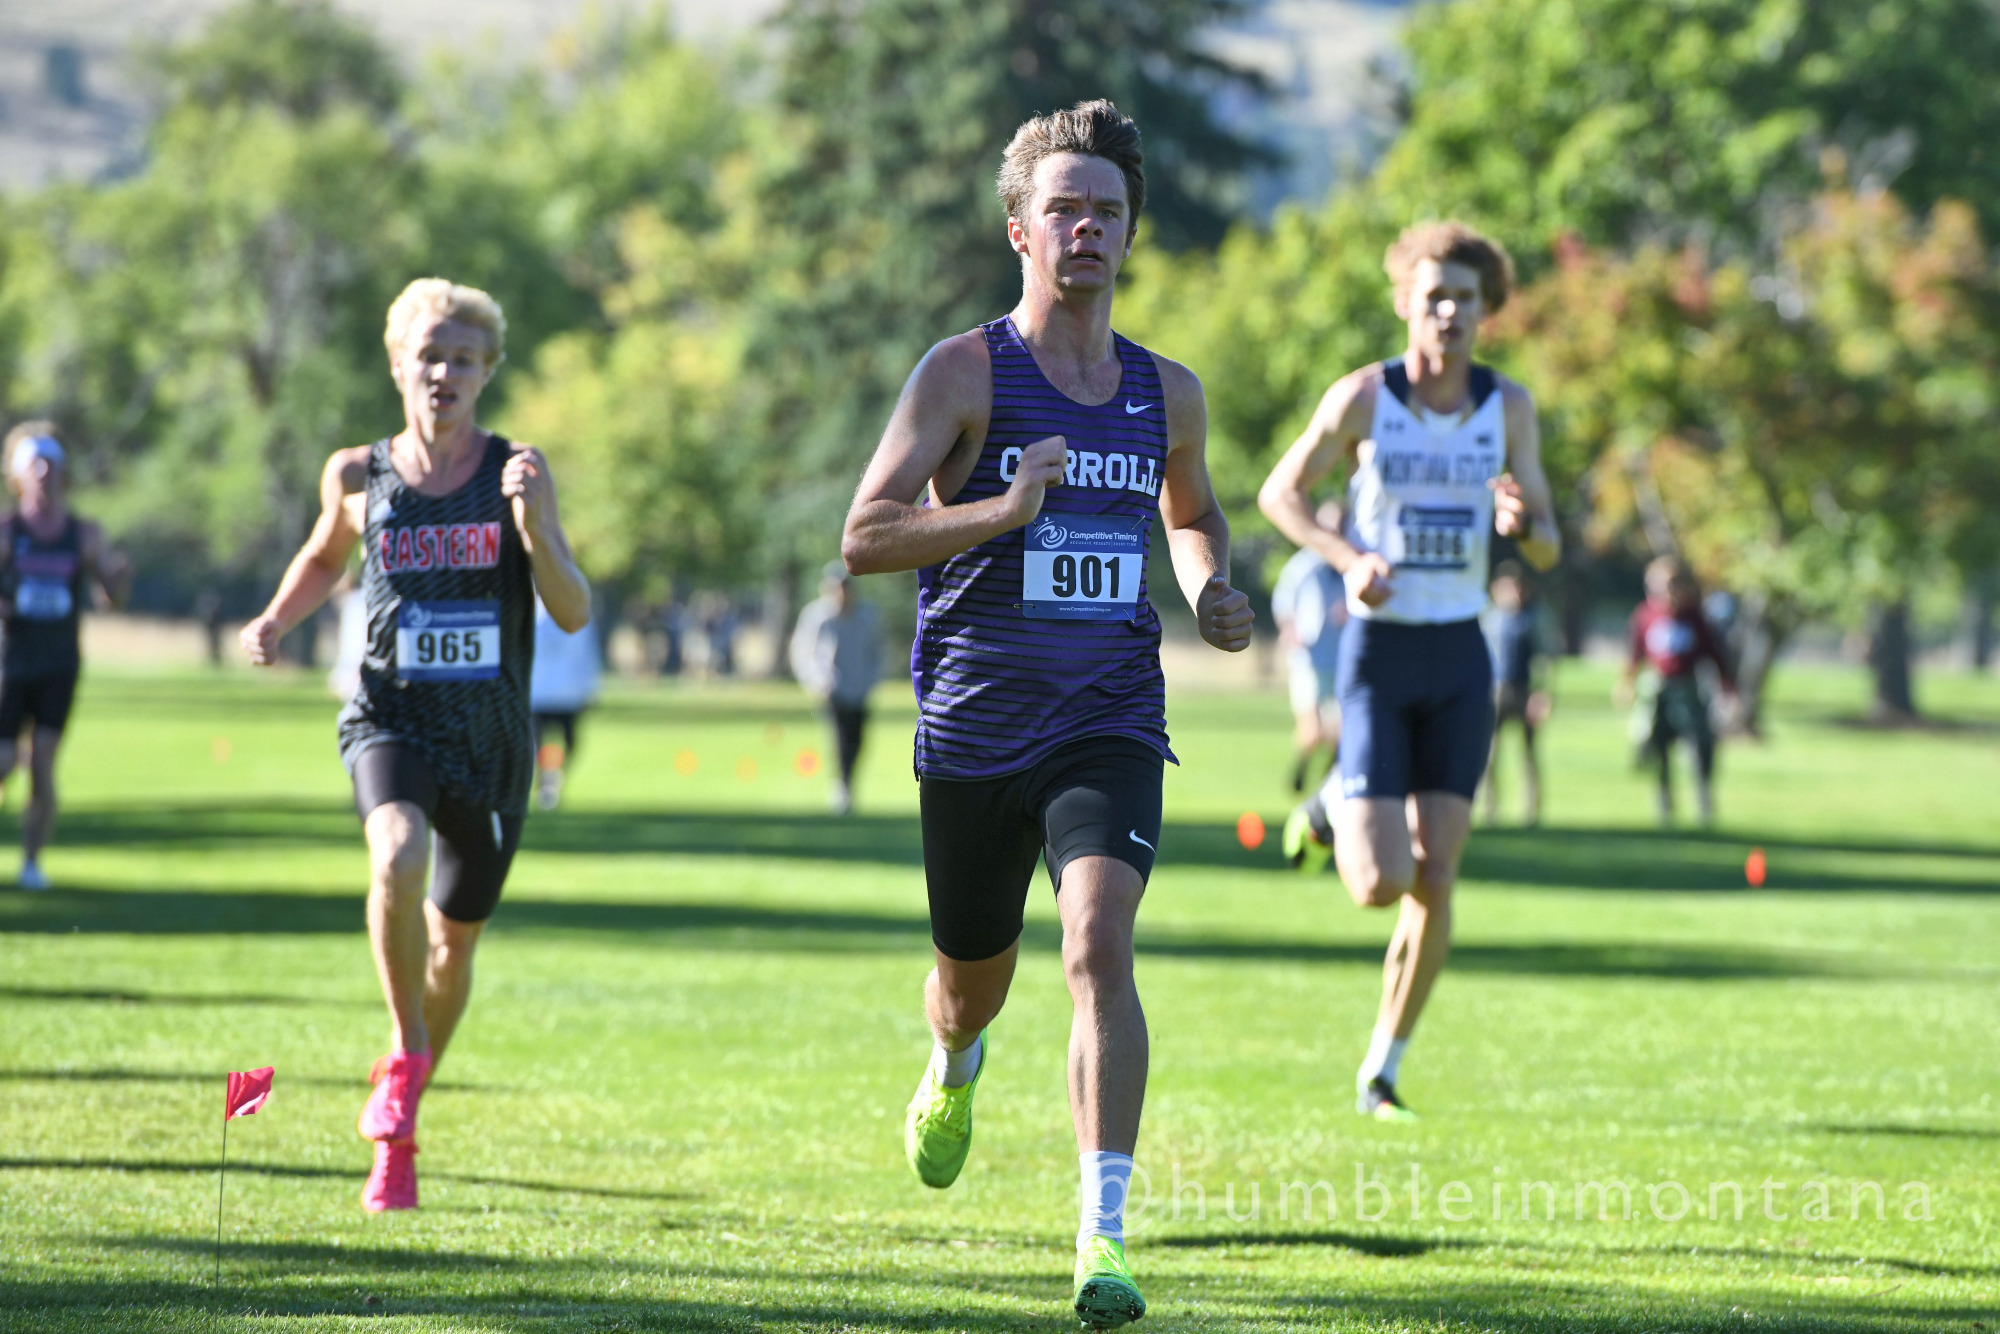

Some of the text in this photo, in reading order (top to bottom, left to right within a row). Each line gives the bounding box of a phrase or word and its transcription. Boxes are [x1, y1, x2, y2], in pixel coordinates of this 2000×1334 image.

[1000, 446, 1158, 497] CRROLL
[378, 521, 501, 576] EASTERN
[1052, 554, 1120, 598] 901
[417, 631, 481, 664] 965
